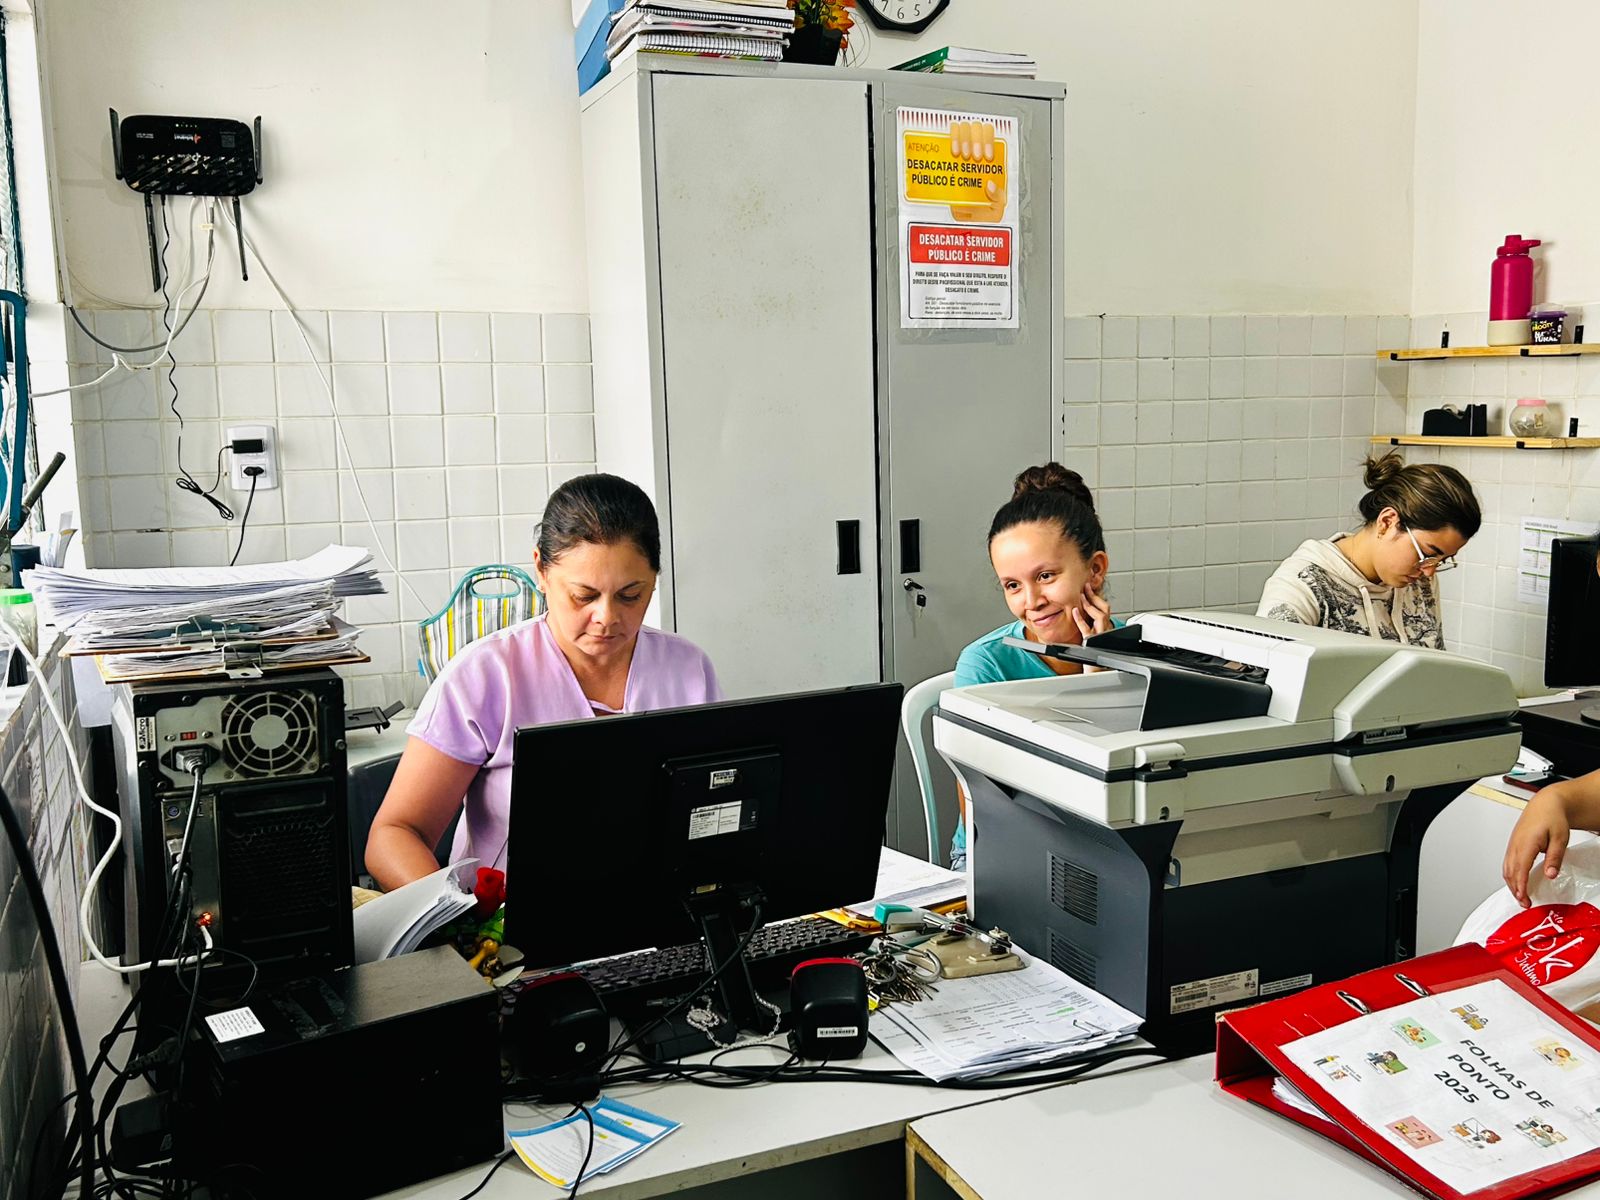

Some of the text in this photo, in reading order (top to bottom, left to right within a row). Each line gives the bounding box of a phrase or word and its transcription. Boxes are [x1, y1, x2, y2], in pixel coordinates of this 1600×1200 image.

[897, 7, 905, 19] 6
[913, 3, 921, 16] 5
[907, 142, 940, 154] ATENÇÃO
[907, 158, 1003, 174] DESACATAR SERVIDOR
[912, 171, 982, 188] PÚBLICO É CRIME
[919, 233, 1004, 248] DESACATAR SERVIDOR
[928, 246, 996, 262] PÚBLICO É CRIME
[1447, 1053, 1511, 1102] PONTO
[1459, 1038, 1555, 1110] FOLHAS DE
[1434, 1070, 1480, 1105] 2025
